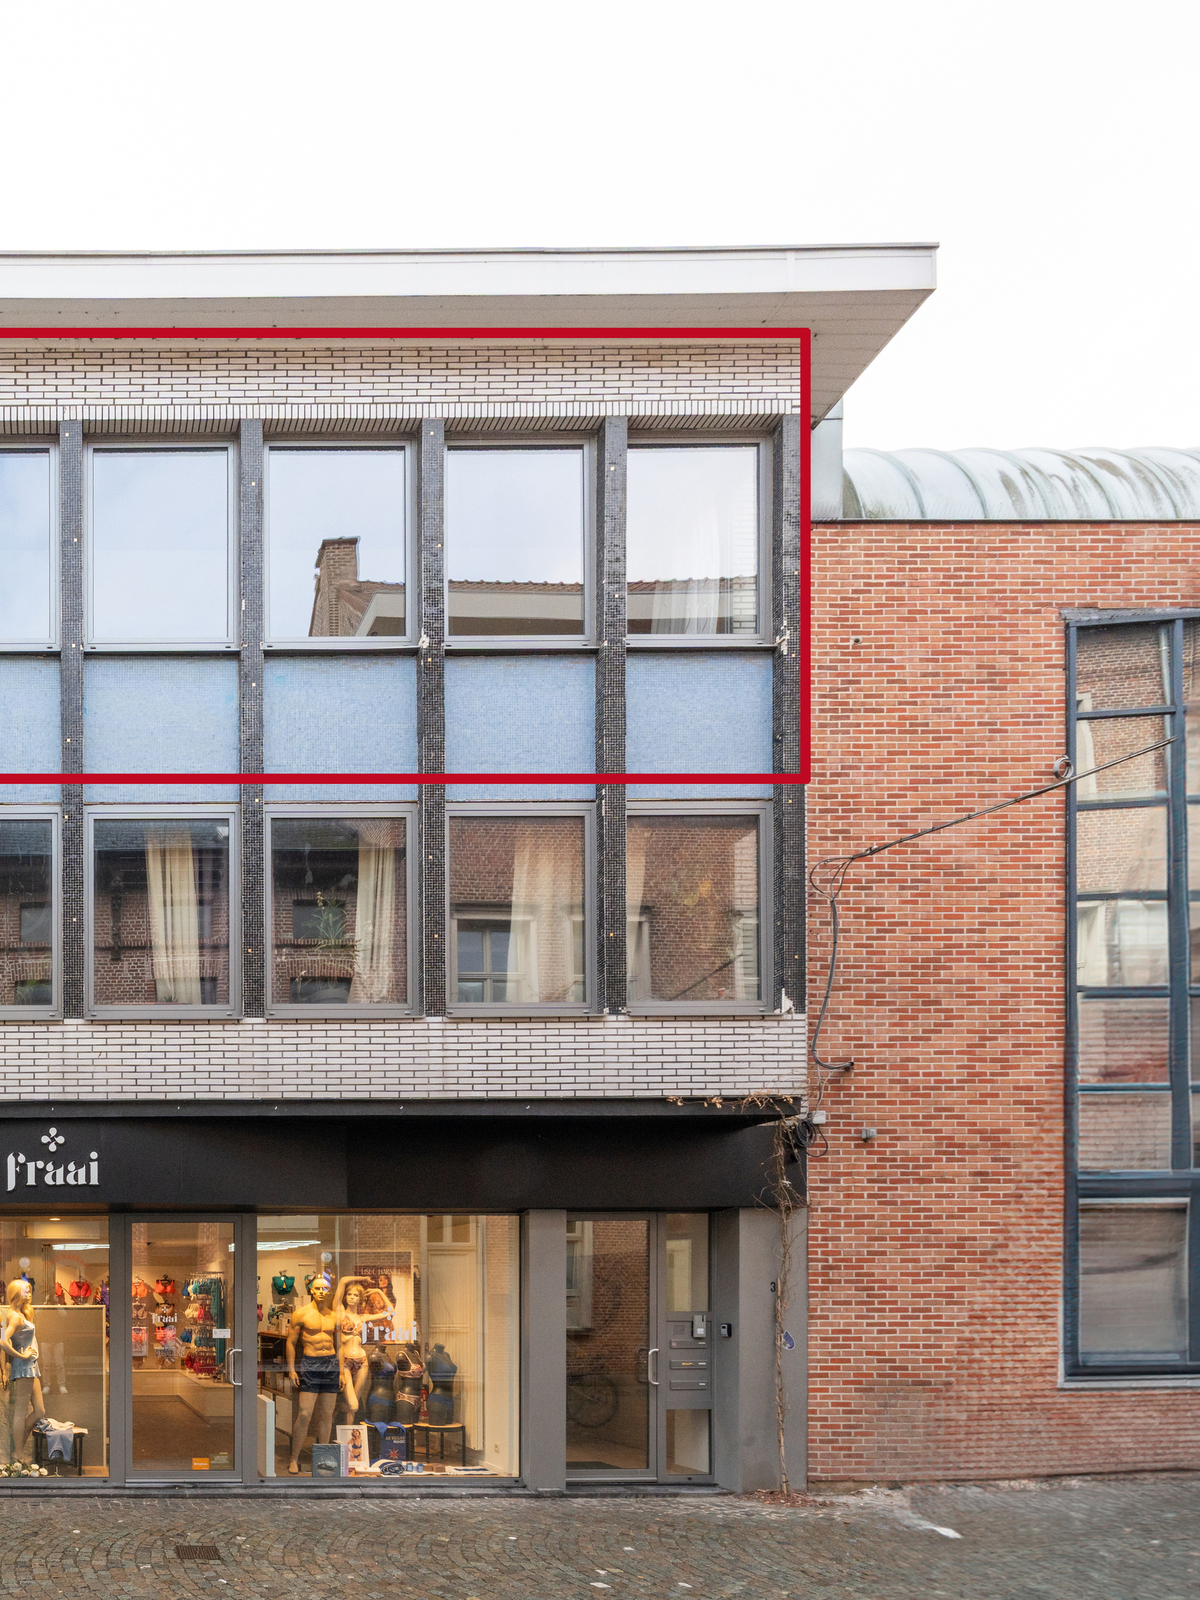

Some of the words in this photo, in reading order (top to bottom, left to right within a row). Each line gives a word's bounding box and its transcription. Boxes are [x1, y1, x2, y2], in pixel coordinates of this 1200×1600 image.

[6, 1151, 100, 1192] fraai
[770, 1281, 776, 1292] 3
[152, 1312, 178, 1325] fraai
[361, 1320, 417, 1345] fraai
